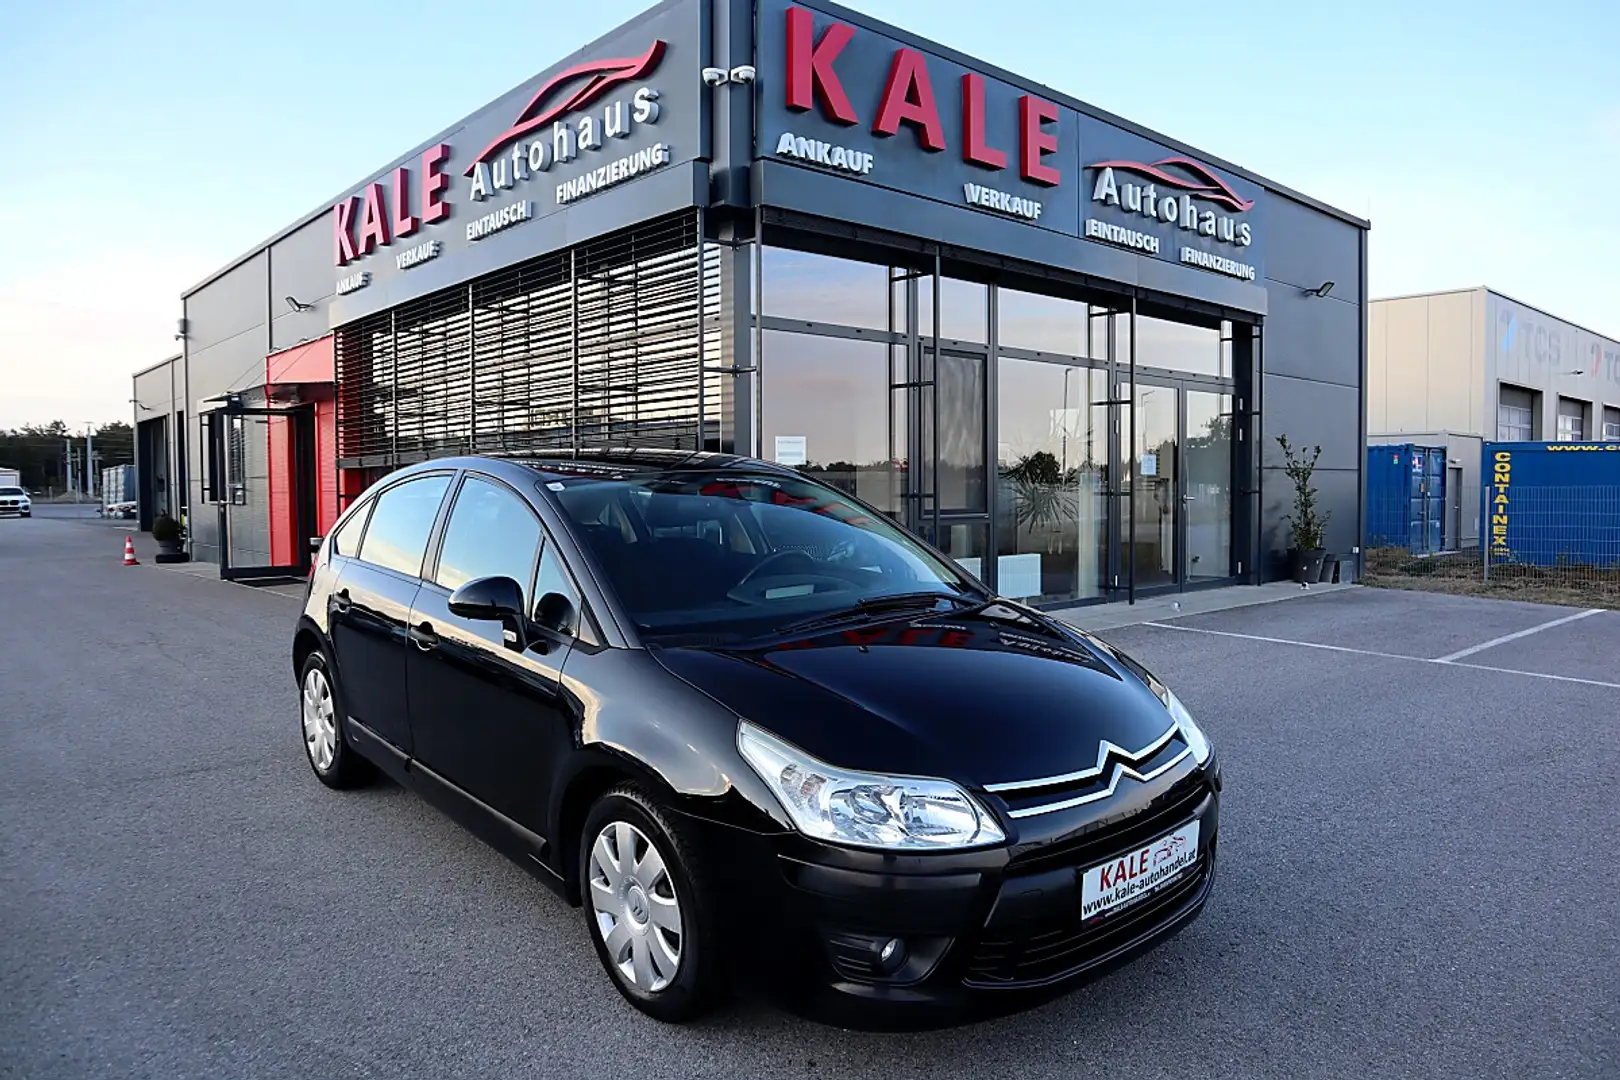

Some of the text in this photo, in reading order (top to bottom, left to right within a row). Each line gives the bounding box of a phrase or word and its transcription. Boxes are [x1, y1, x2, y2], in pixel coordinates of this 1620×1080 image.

[470, 86, 659, 201] Autohaus
[786, 6, 1061, 188] KALE
[334, 143, 450, 267] KALE
[336, 143, 668, 295] ANKAUF VERKAUF EINTAUSCH FINANZIERUNG
[776, 132, 1256, 281] ANKAUF VERKAUF EINTAUSCH FINANZIERUNG
[1093, 166, 1252, 247] Autohaus
[1082, 847, 1197, 916] www.kale-autohandel.at
[1099, 848, 1150, 892] KALE
